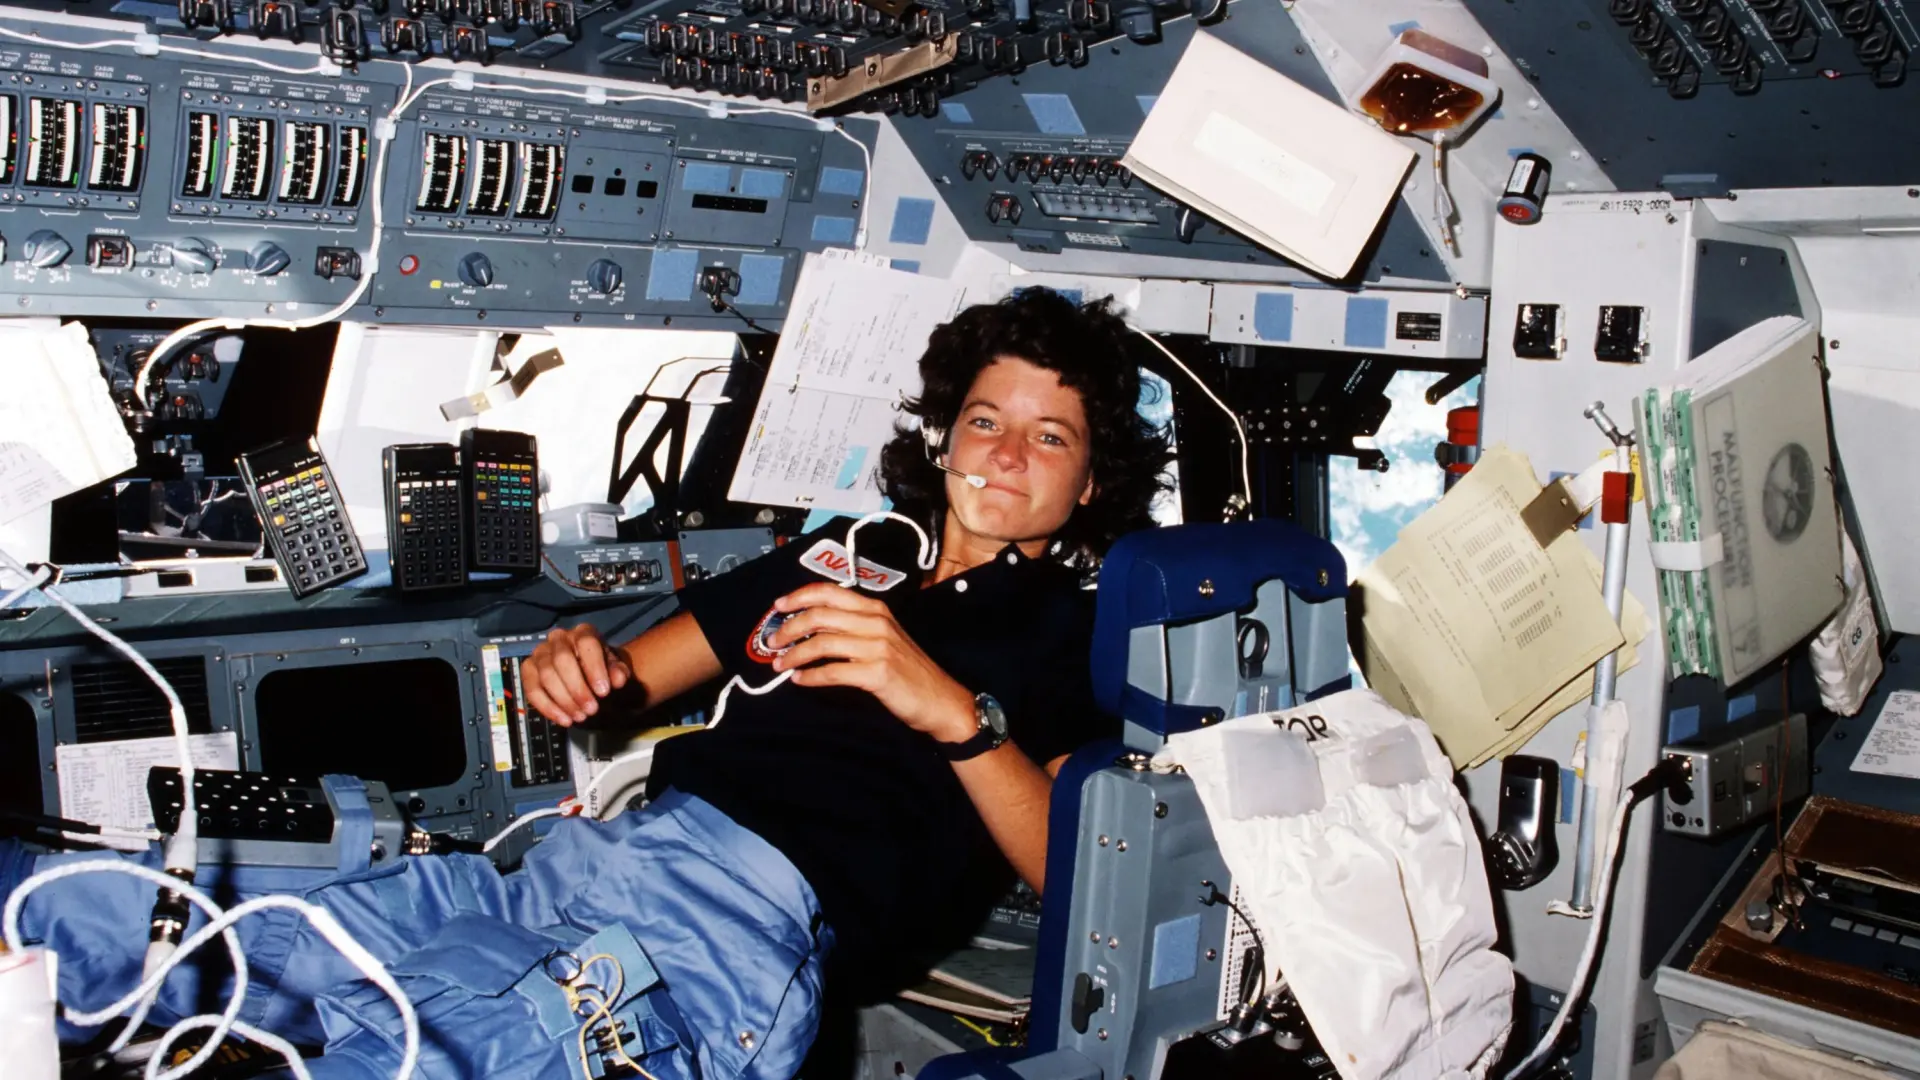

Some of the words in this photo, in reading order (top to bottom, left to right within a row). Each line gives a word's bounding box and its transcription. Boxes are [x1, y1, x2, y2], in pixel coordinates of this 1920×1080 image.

[251, 75, 271, 83] CRYO
[1722, 431, 1752, 588] MALFUNCTION
[813, 550, 888, 585] NASA
